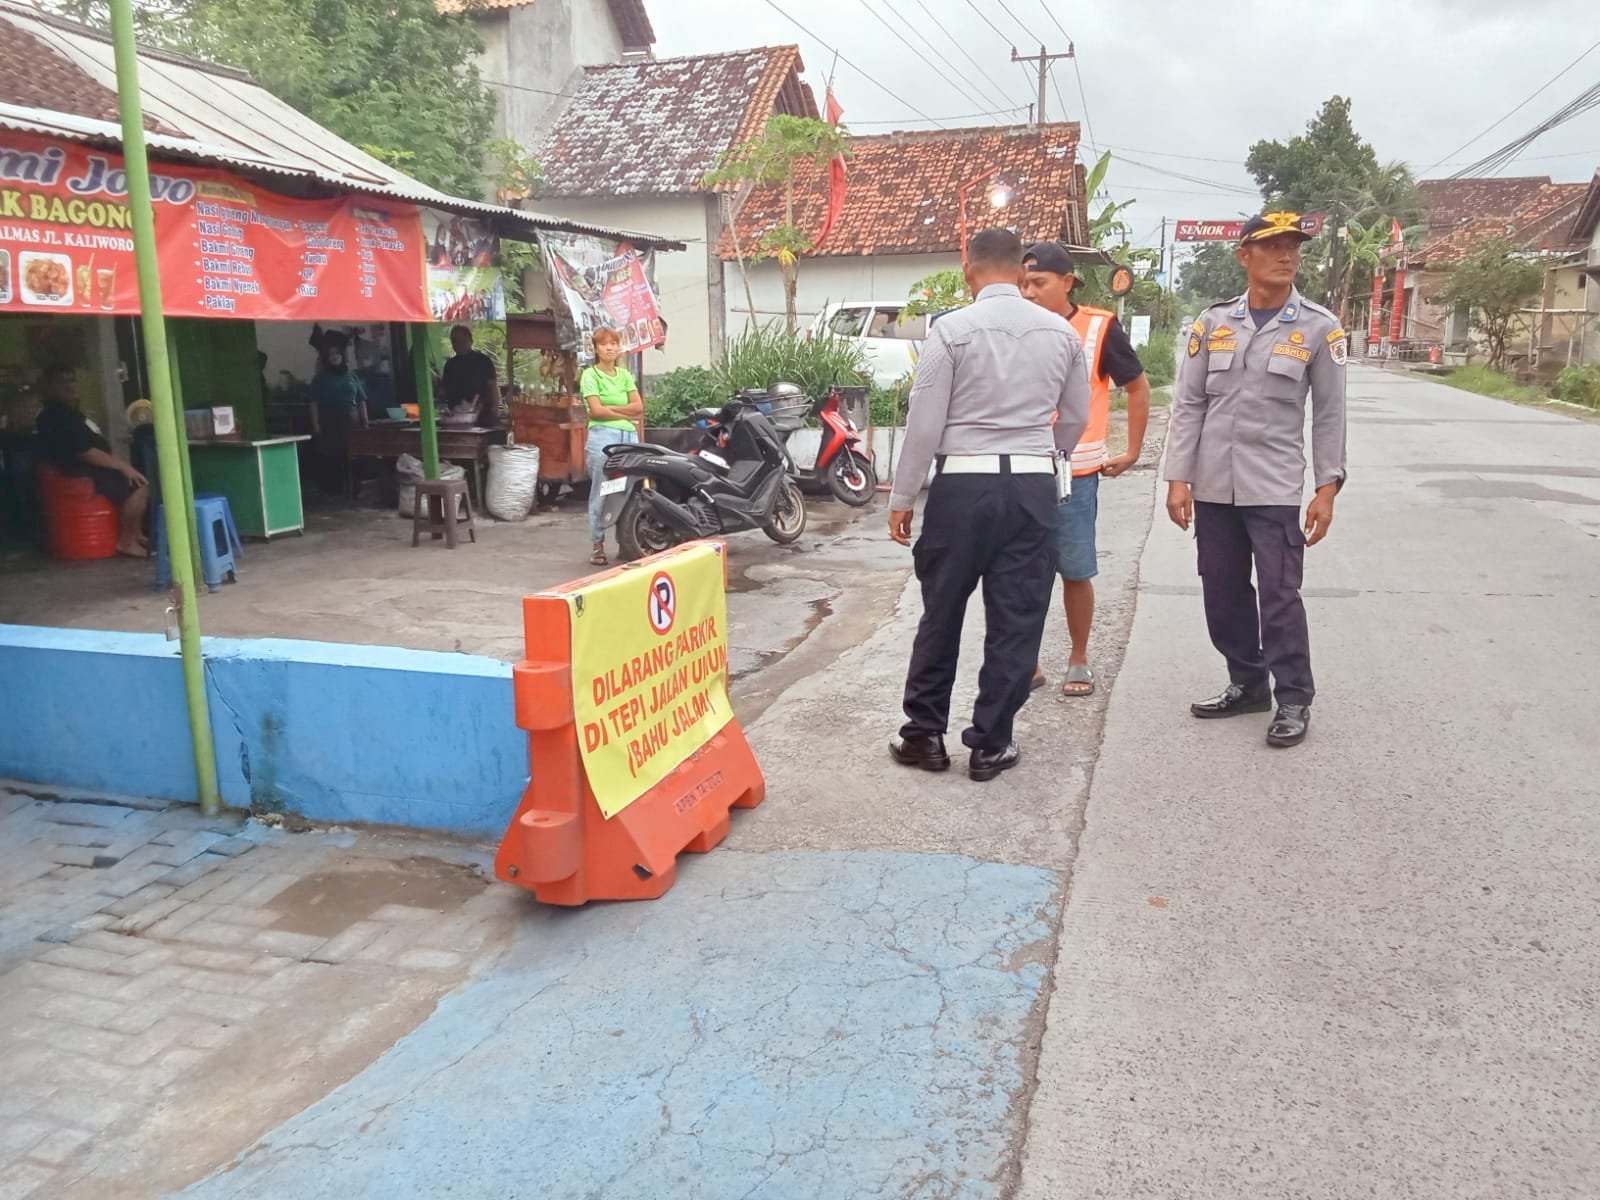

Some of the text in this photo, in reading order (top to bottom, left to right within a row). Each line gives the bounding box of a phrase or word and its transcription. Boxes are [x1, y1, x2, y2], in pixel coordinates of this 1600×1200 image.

[196, 201, 219, 218] Nasi
[199, 220, 221, 237] Nasi
[42, 229, 63, 245] JL.
[64, 232, 135, 253] KALIWORO
[201, 238, 230, 256] Bakmi
[203, 256, 231, 274] Bakmi
[204, 275, 233, 292] Bakmi
[592, 640, 675, 707] DILARANG
[583, 717, 609, 753] DI
[607, 693, 647, 738] TEPI
[649, 664, 689, 715] JALAN
[626, 718, 669, 779] (BAHU
